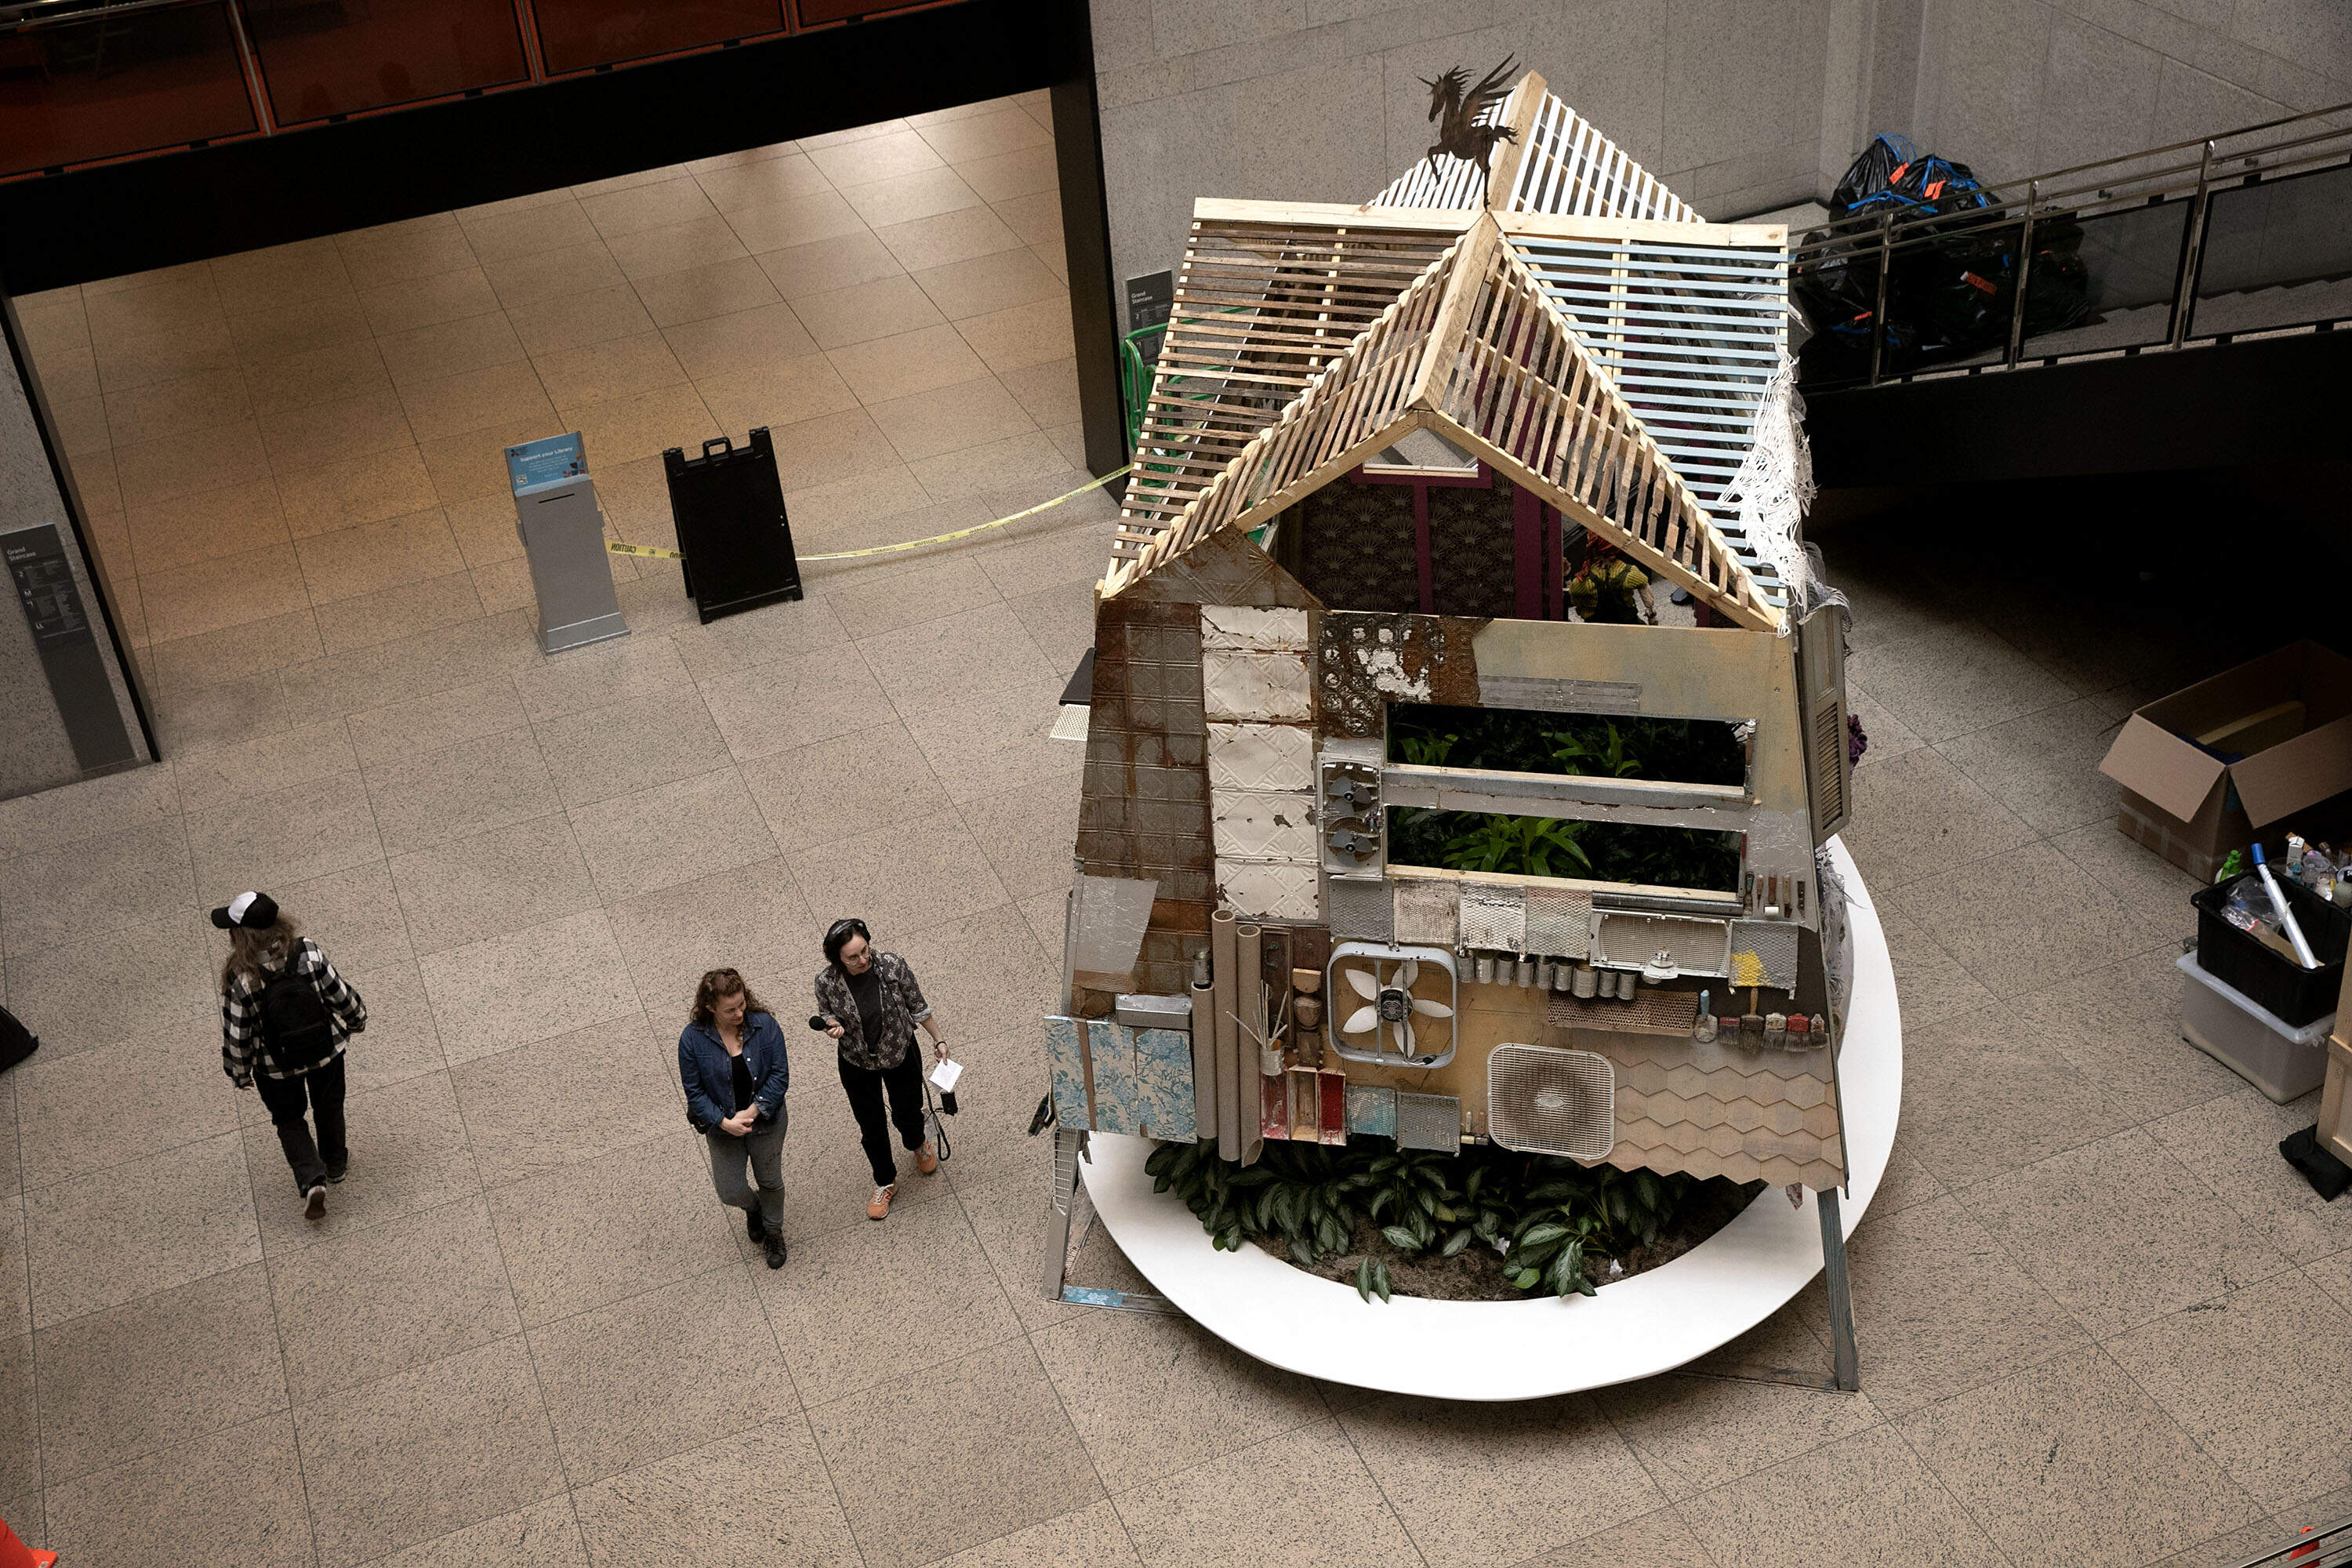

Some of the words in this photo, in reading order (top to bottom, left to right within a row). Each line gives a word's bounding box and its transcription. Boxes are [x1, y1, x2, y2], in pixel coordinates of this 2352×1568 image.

[1131, 296, 1152, 304] Staircase
[520, 454, 541, 463] Support
[6, 546, 26, 555] Grand
[9, 552, 36, 561] Staircase
